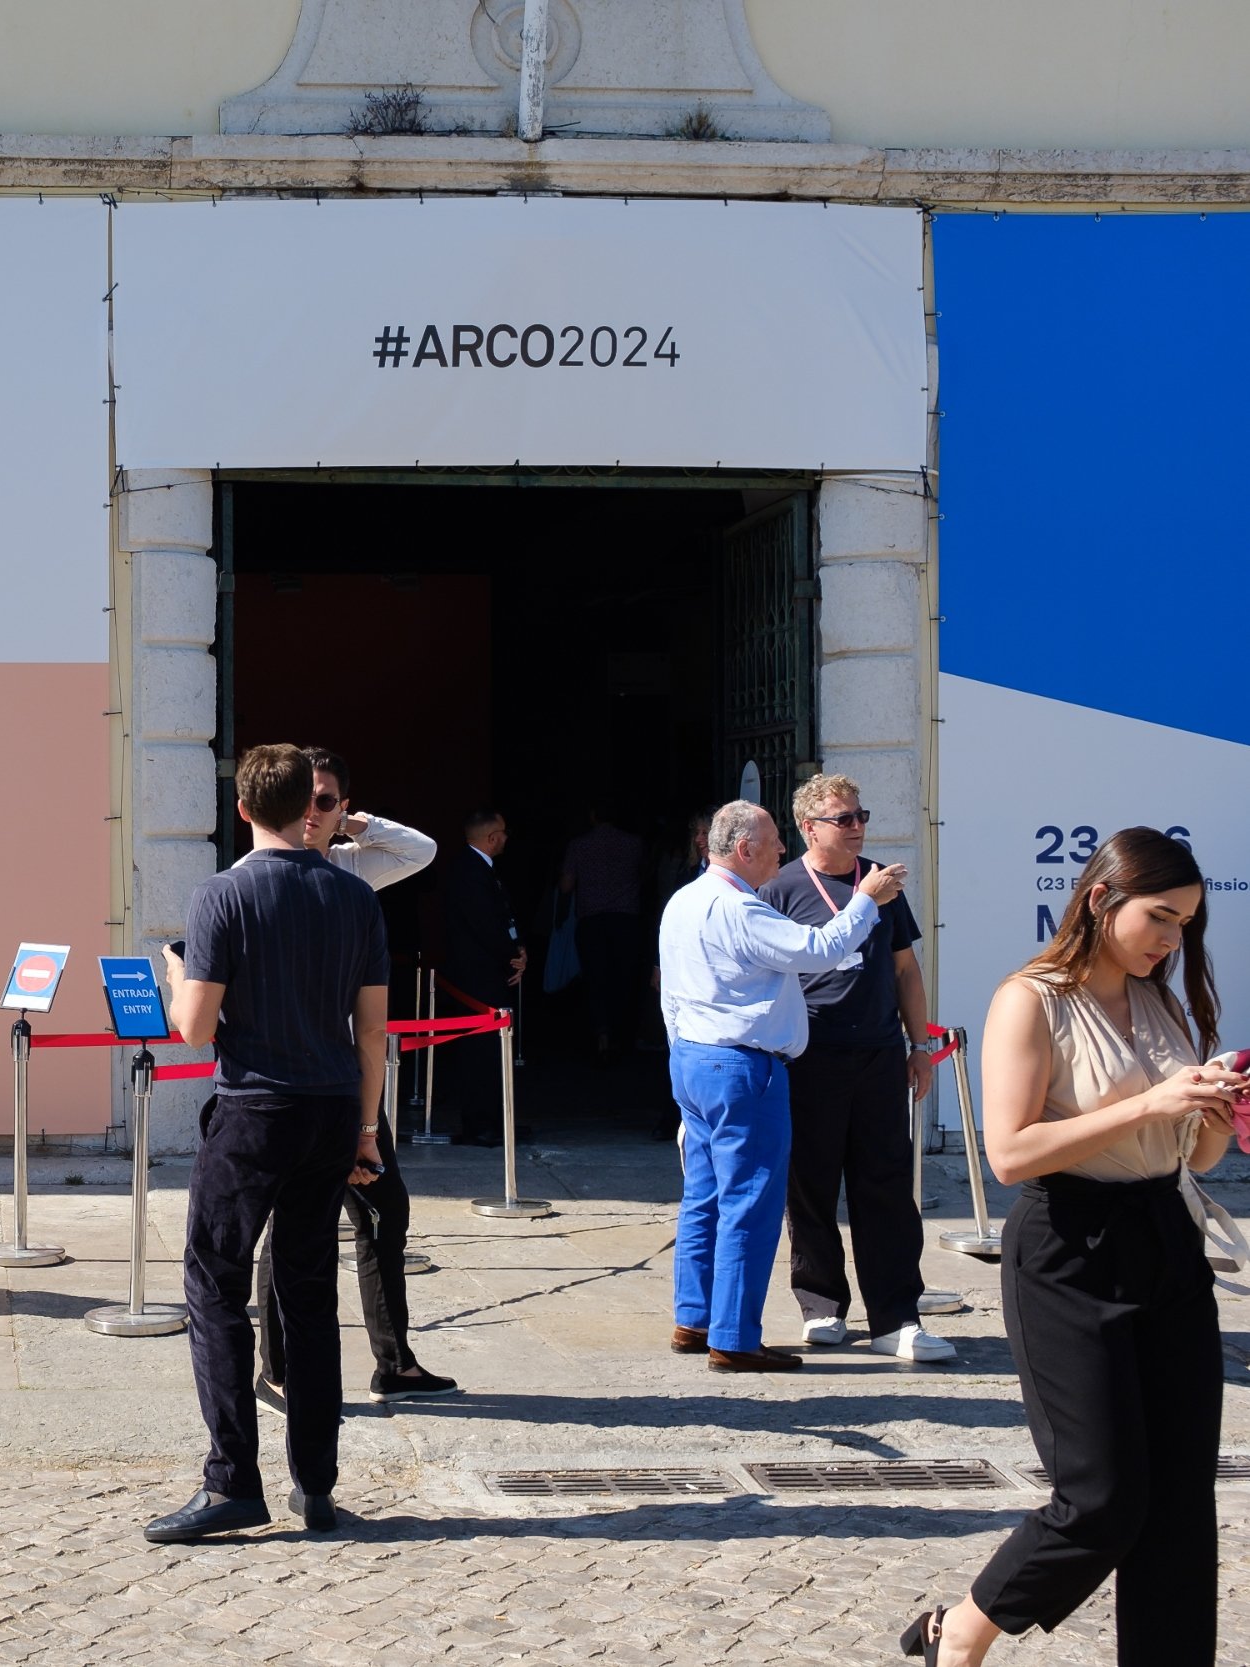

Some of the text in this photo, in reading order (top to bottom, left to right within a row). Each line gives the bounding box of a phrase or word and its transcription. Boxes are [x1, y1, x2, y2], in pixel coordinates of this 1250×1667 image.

[373, 324, 681, 368] #ARCO2024
[1036, 875, 1065, 892] (23
[112, 988, 156, 999] ENTRADA
[123, 1004, 152, 1015] ENTRY
